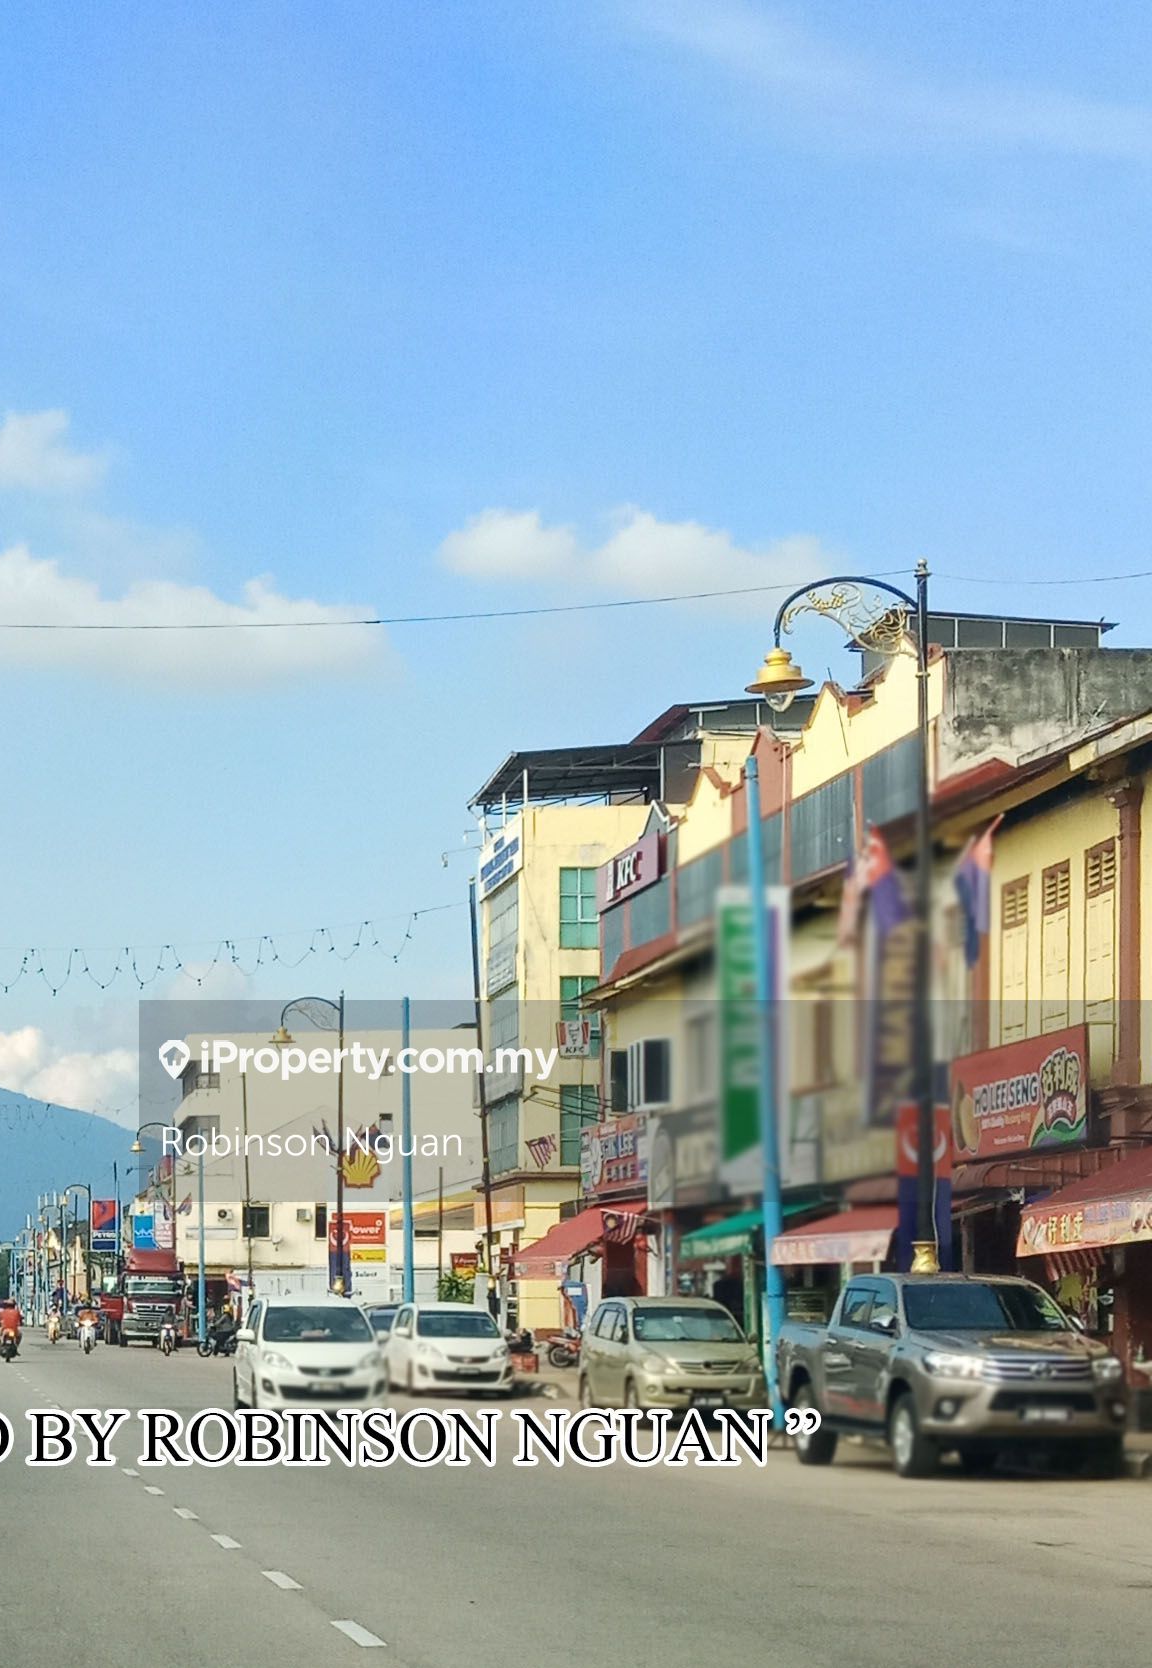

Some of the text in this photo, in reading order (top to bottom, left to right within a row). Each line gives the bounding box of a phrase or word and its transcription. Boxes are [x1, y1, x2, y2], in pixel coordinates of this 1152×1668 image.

[616, 851, 640, 890] KFC
[990, 1079, 1008, 1112] LEE
[1008, 1073, 1040, 1108] SENG
